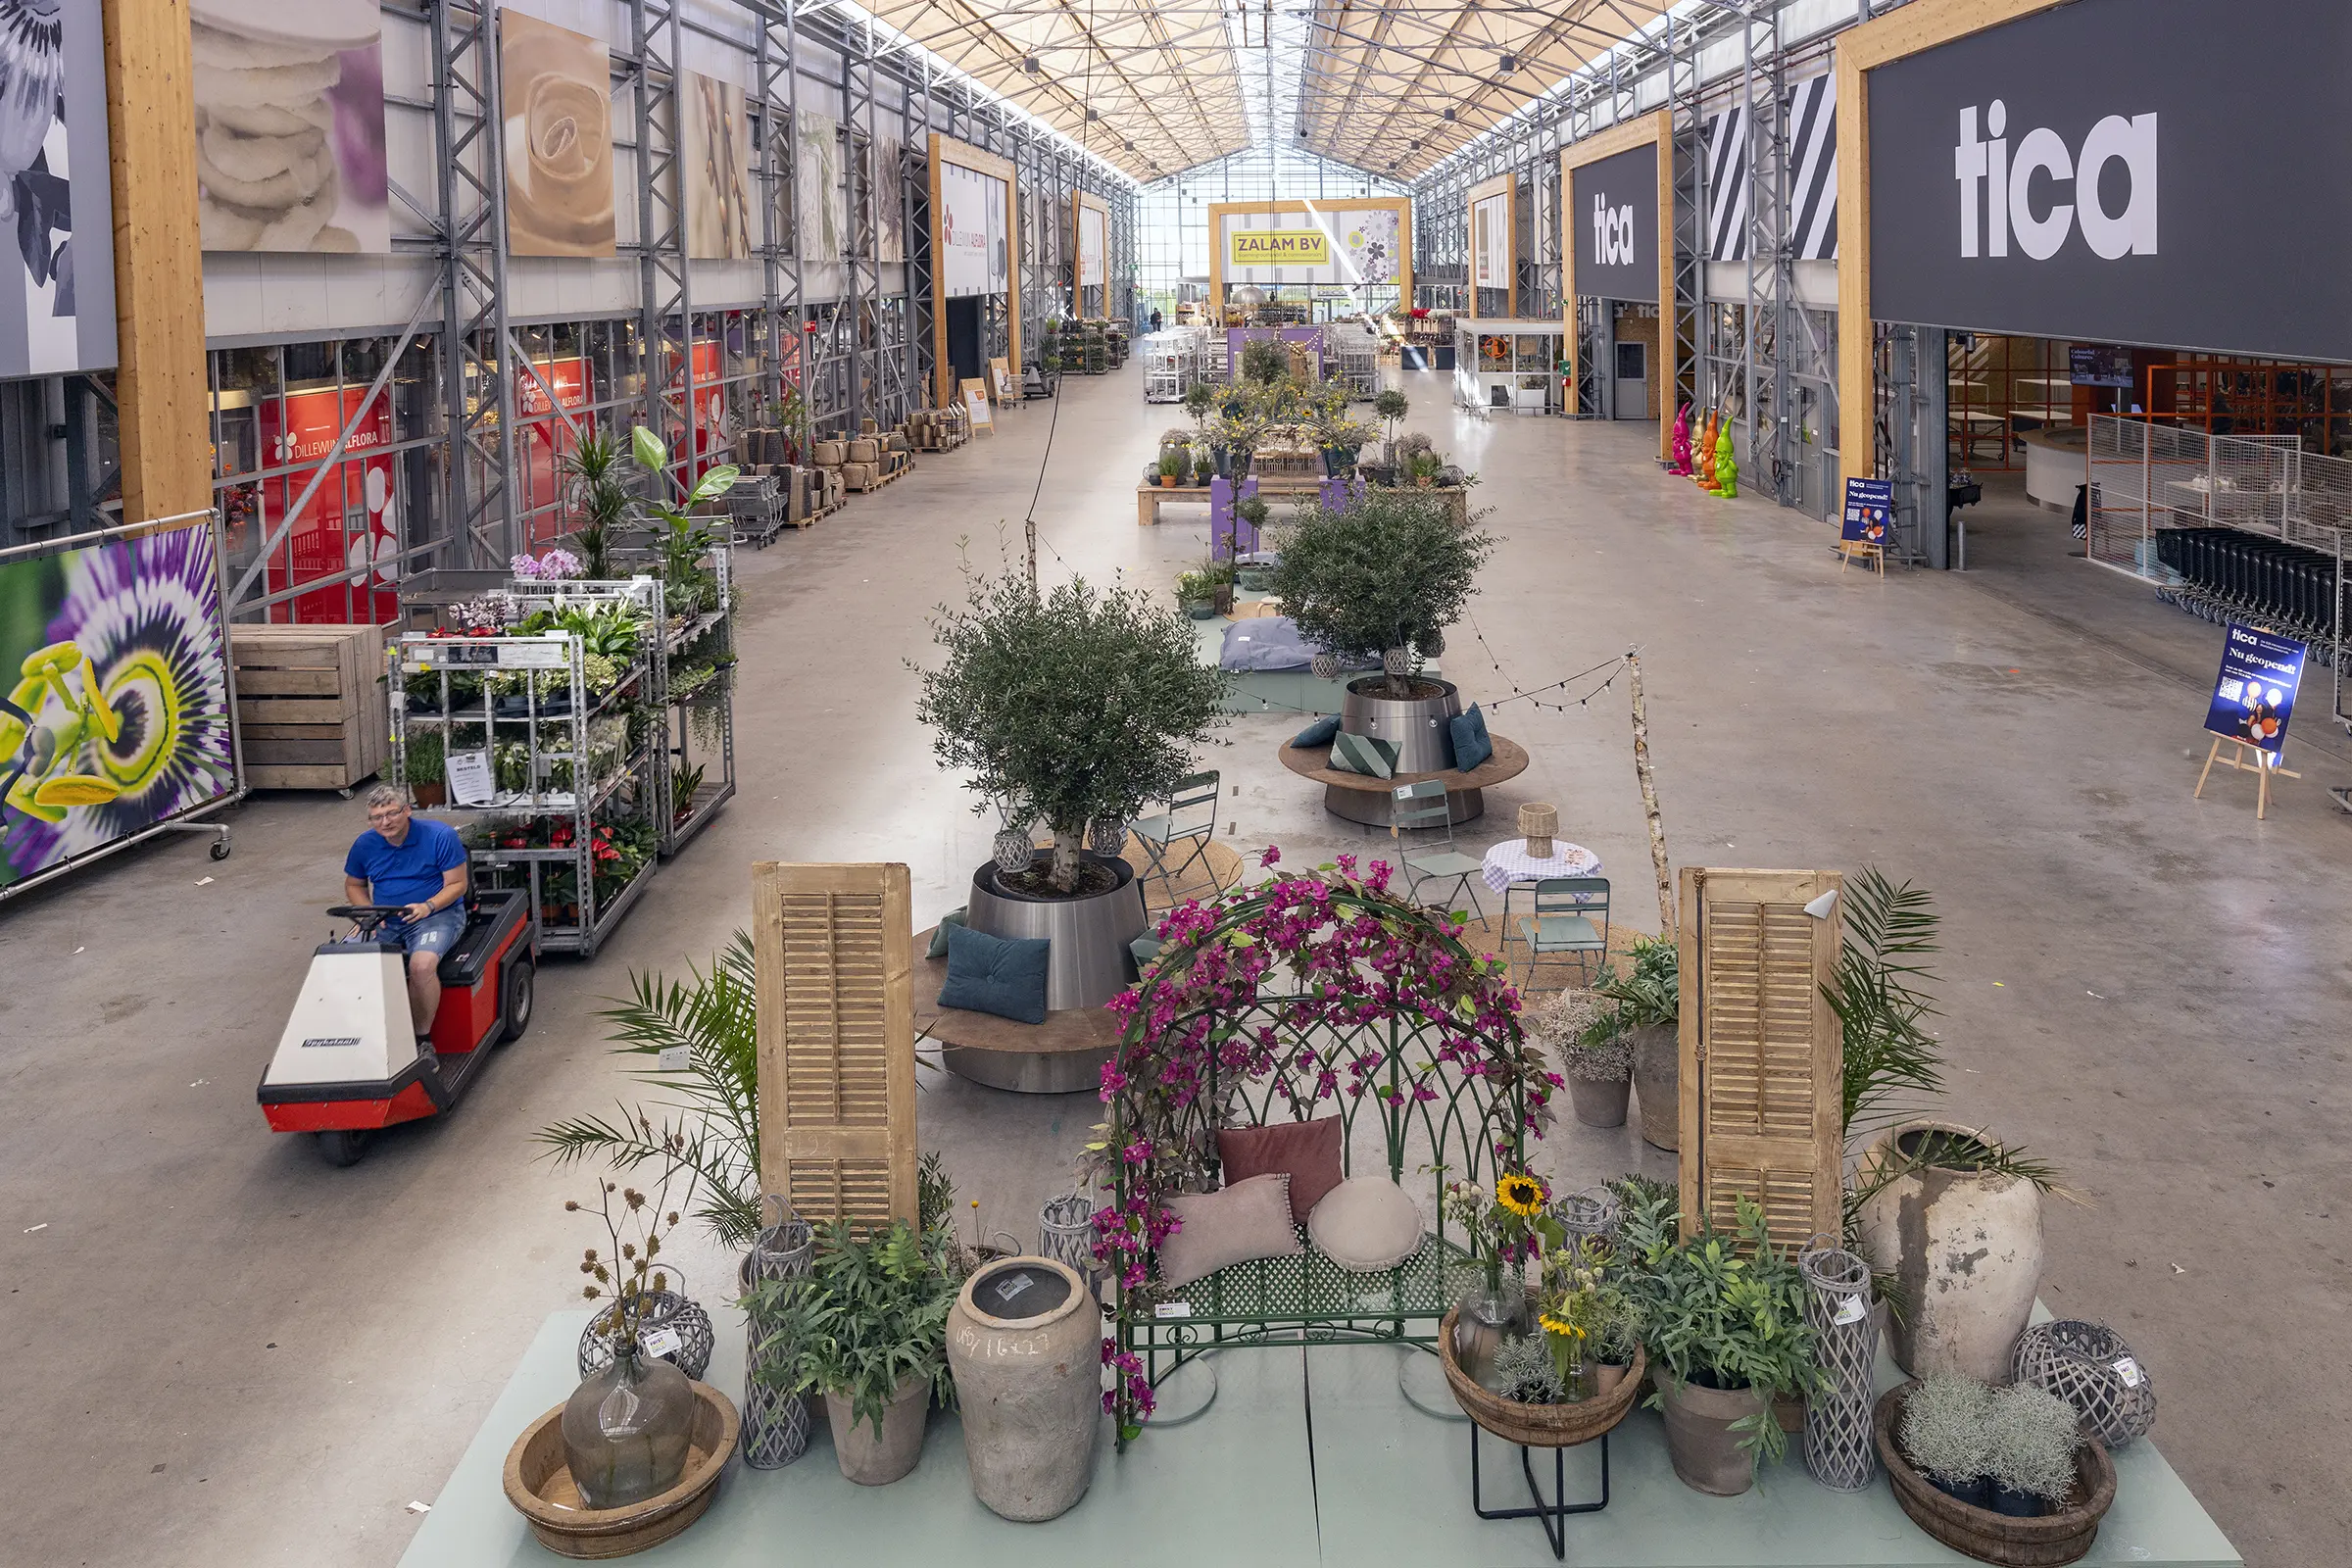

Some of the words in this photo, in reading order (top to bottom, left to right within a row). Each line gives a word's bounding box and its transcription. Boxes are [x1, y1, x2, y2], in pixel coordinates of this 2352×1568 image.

[1955, 98, 2158, 261] tica
[1593, 192, 1634, 266] tica
[1238, 238, 1295, 251] ZALAM
[1299, 237, 1322, 250] BV
[1637, 304, 1660, 318] tic
[2231, 628, 2258, 646] tica
[2229, 647, 2244, 660] Nu
